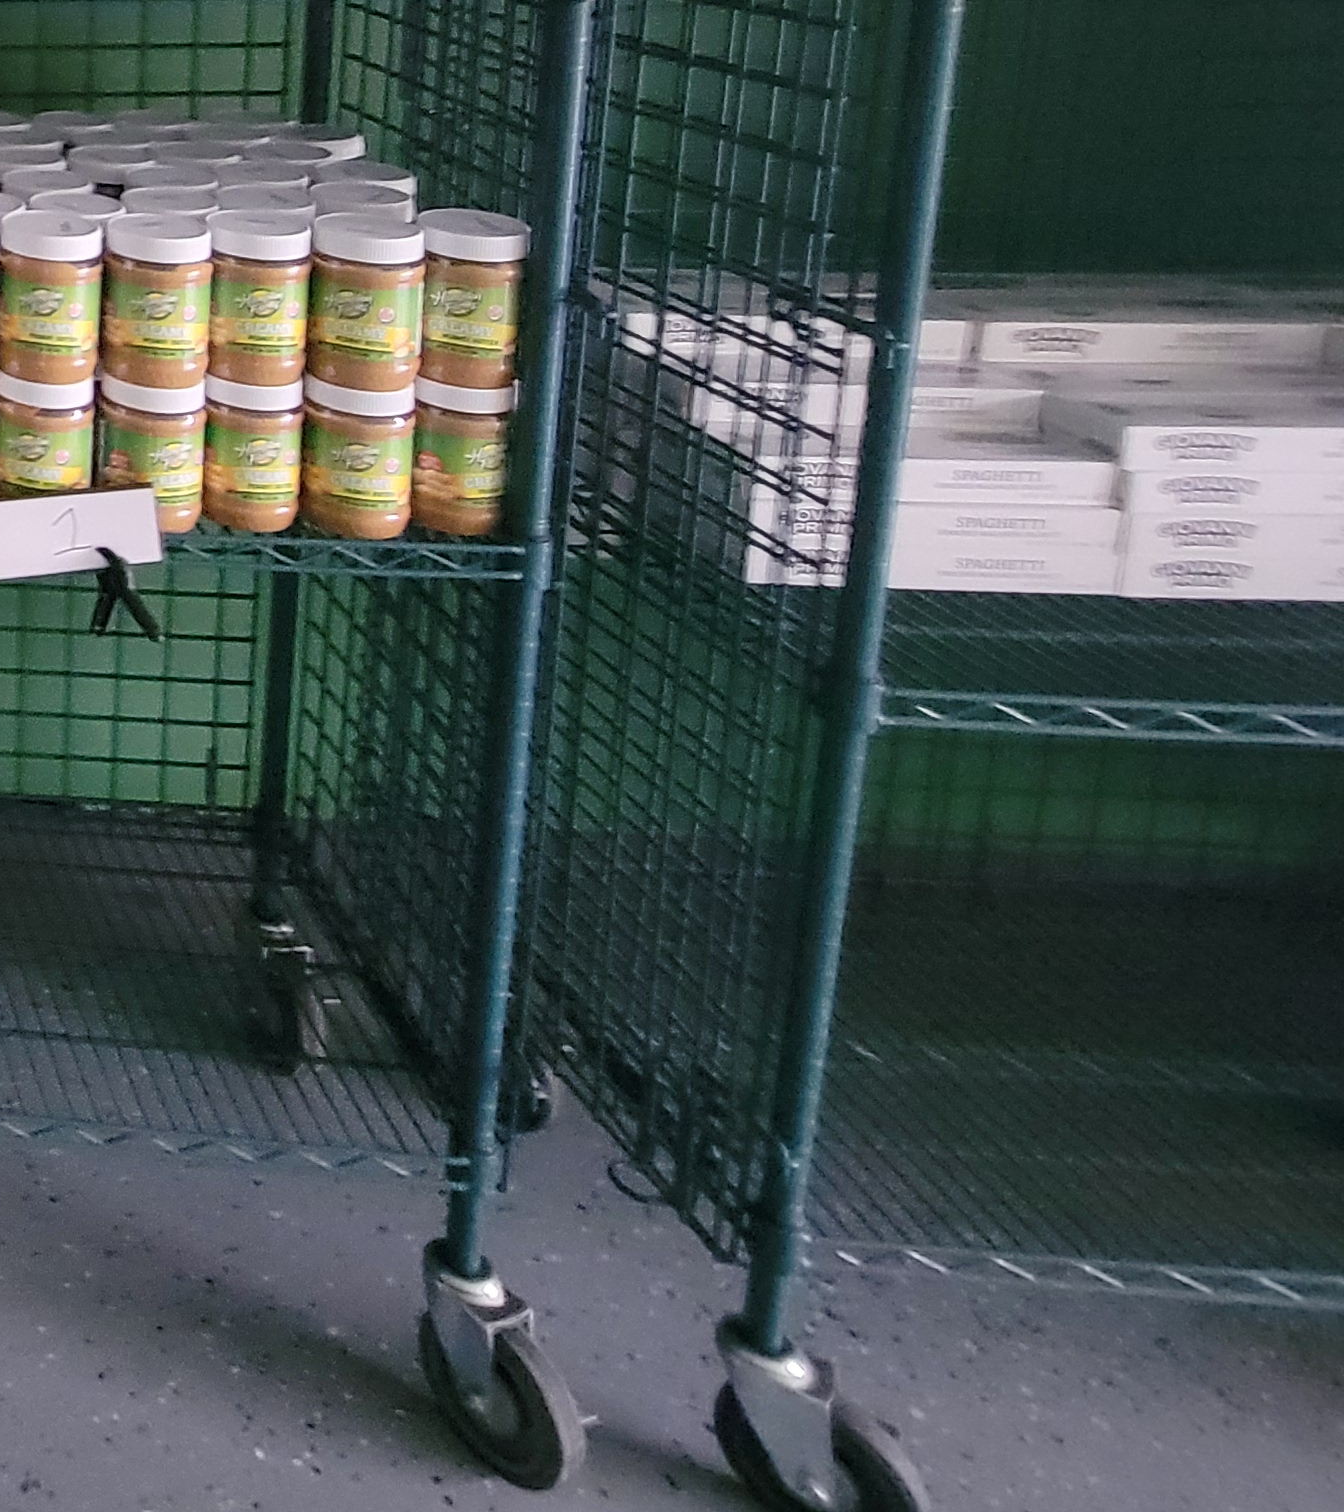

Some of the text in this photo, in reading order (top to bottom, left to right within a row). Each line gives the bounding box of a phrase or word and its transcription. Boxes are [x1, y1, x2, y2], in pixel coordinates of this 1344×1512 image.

[952, 469, 1043, 483] SPAGHETTI
[956, 516, 1047, 530] SPAGHETTI
[52, 507, 92, 556] 1
[955, 557, 1047, 571] SPAGHETTI
